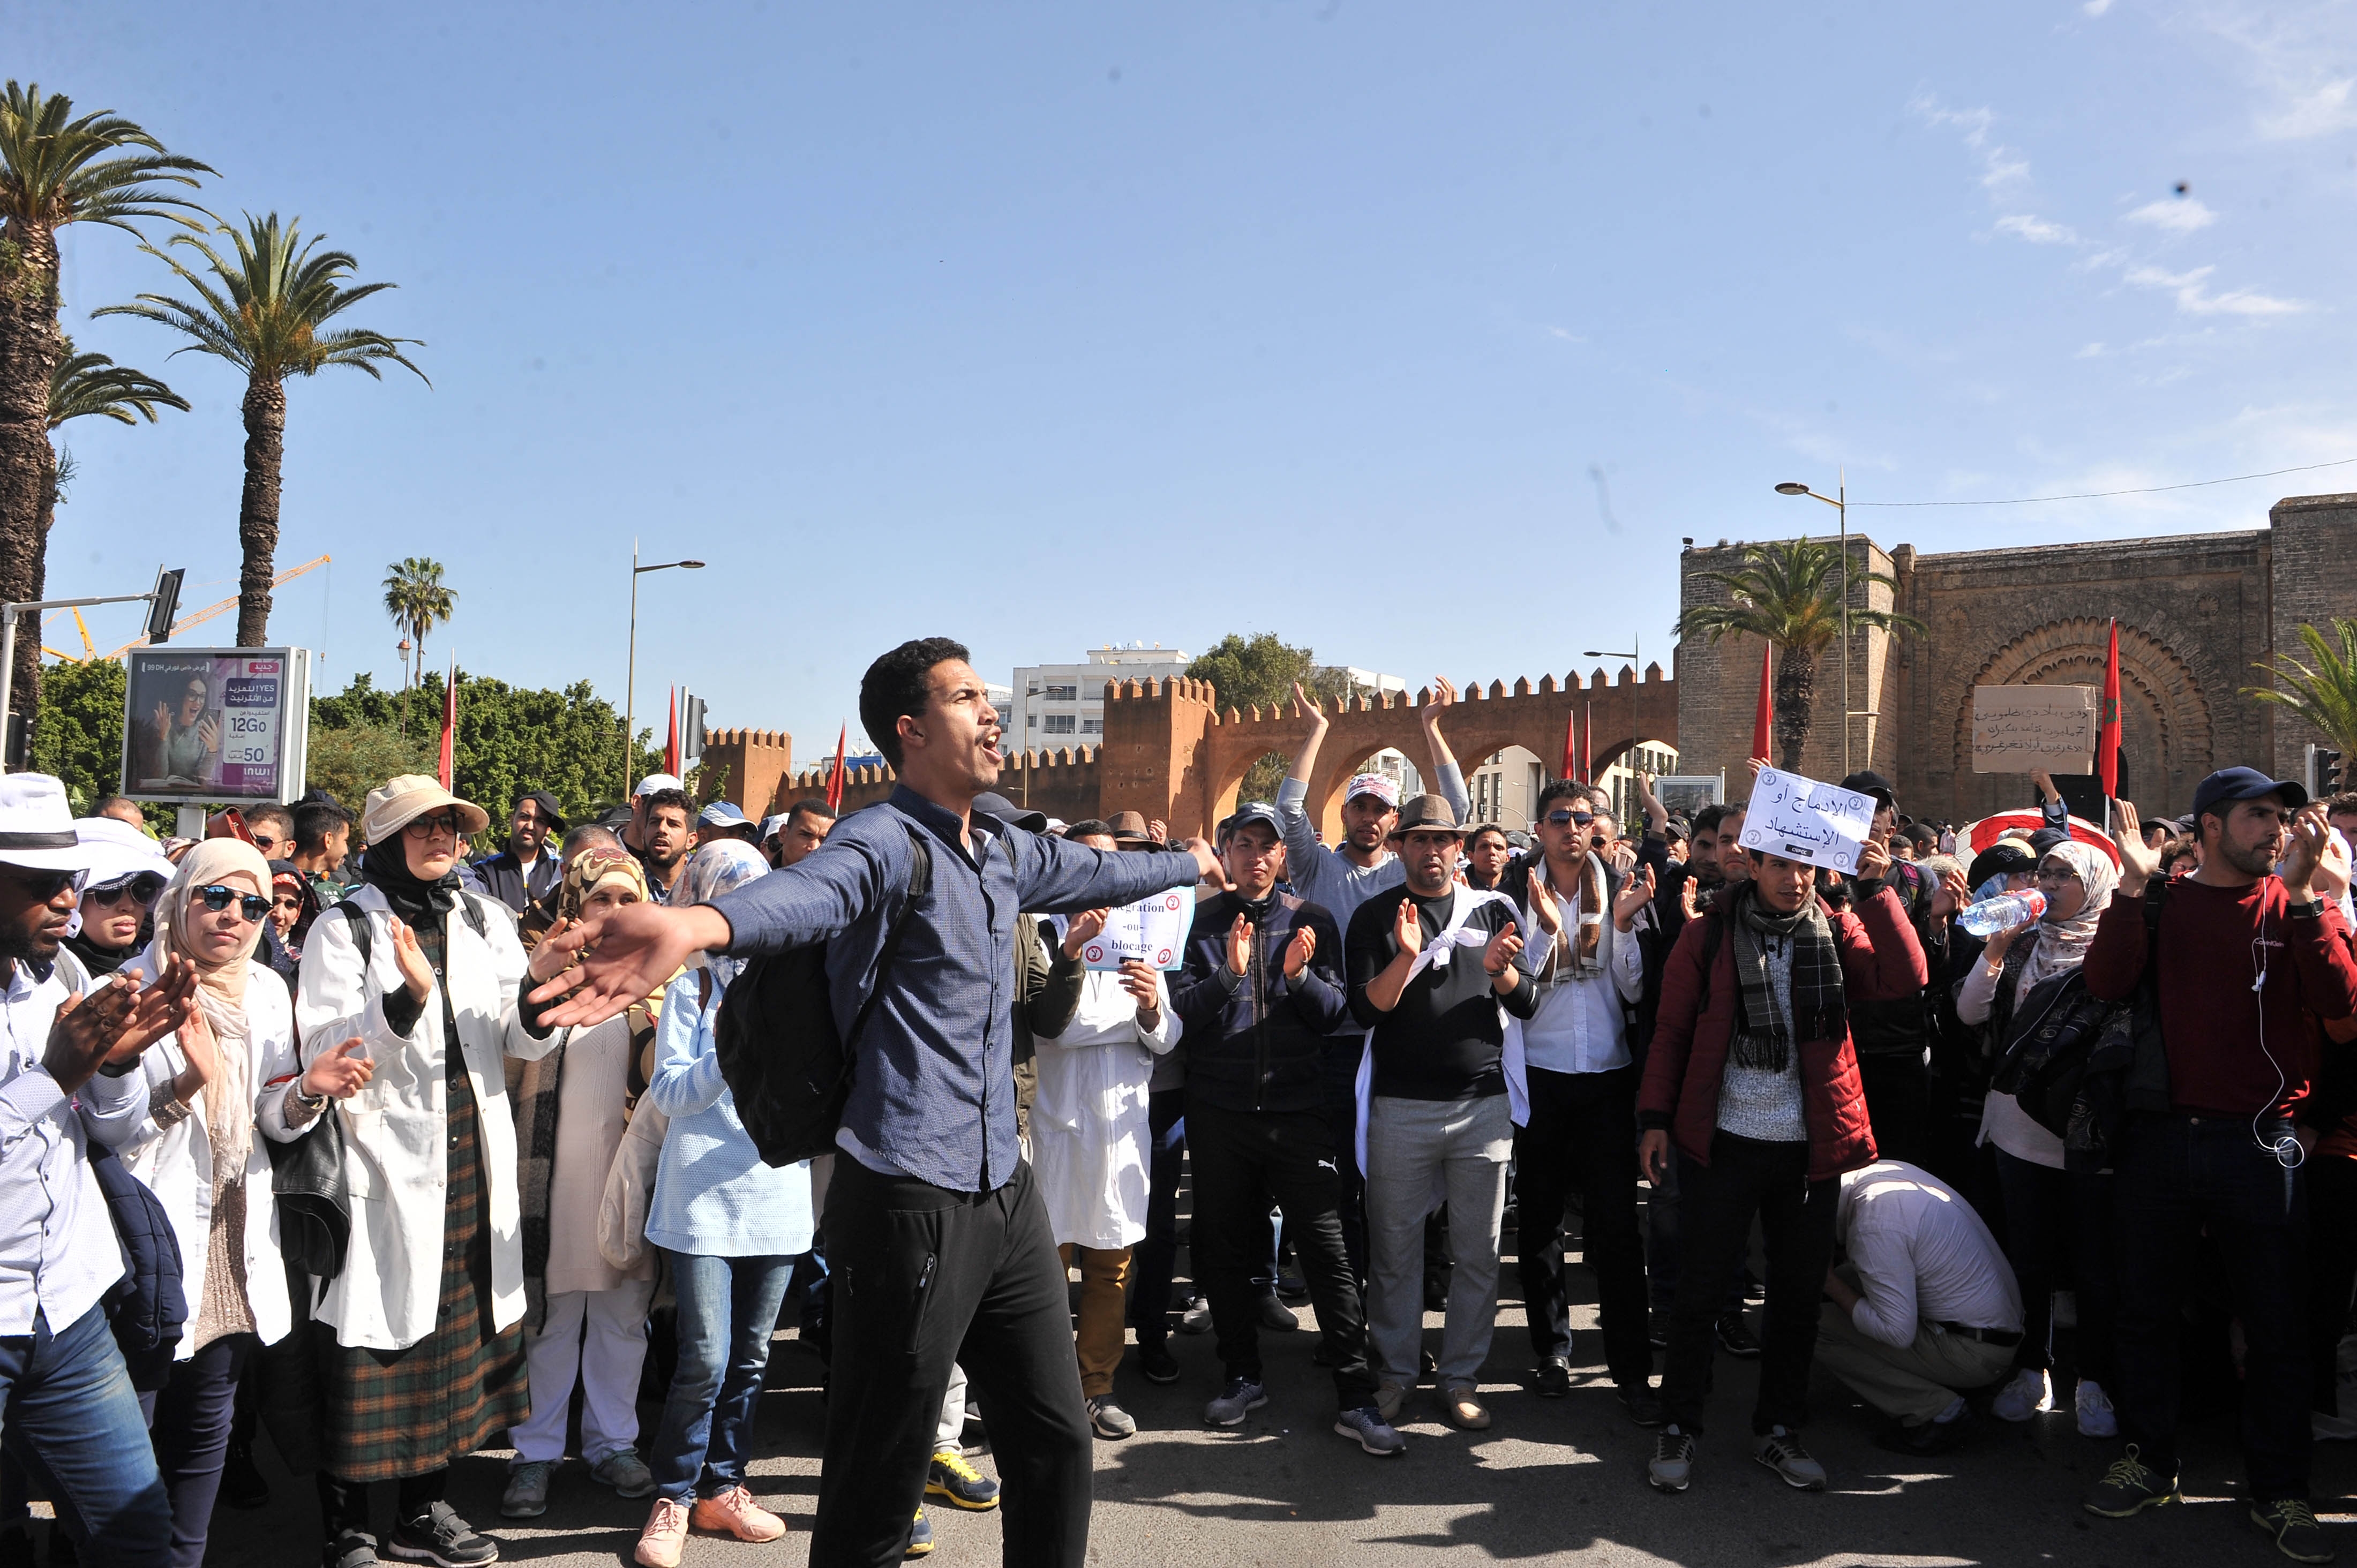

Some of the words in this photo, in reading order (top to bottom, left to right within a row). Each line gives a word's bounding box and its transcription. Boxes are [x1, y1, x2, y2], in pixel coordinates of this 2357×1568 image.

[231, 718, 266, 733] 12Go
[244, 748, 264, 762] 50
[1769, 783, 1790, 804] أو
[1791, 794, 1848, 819] الإدماج
[1765, 816, 1840, 849] الإستشهاد
[1112, 939, 1153, 954] blocage
